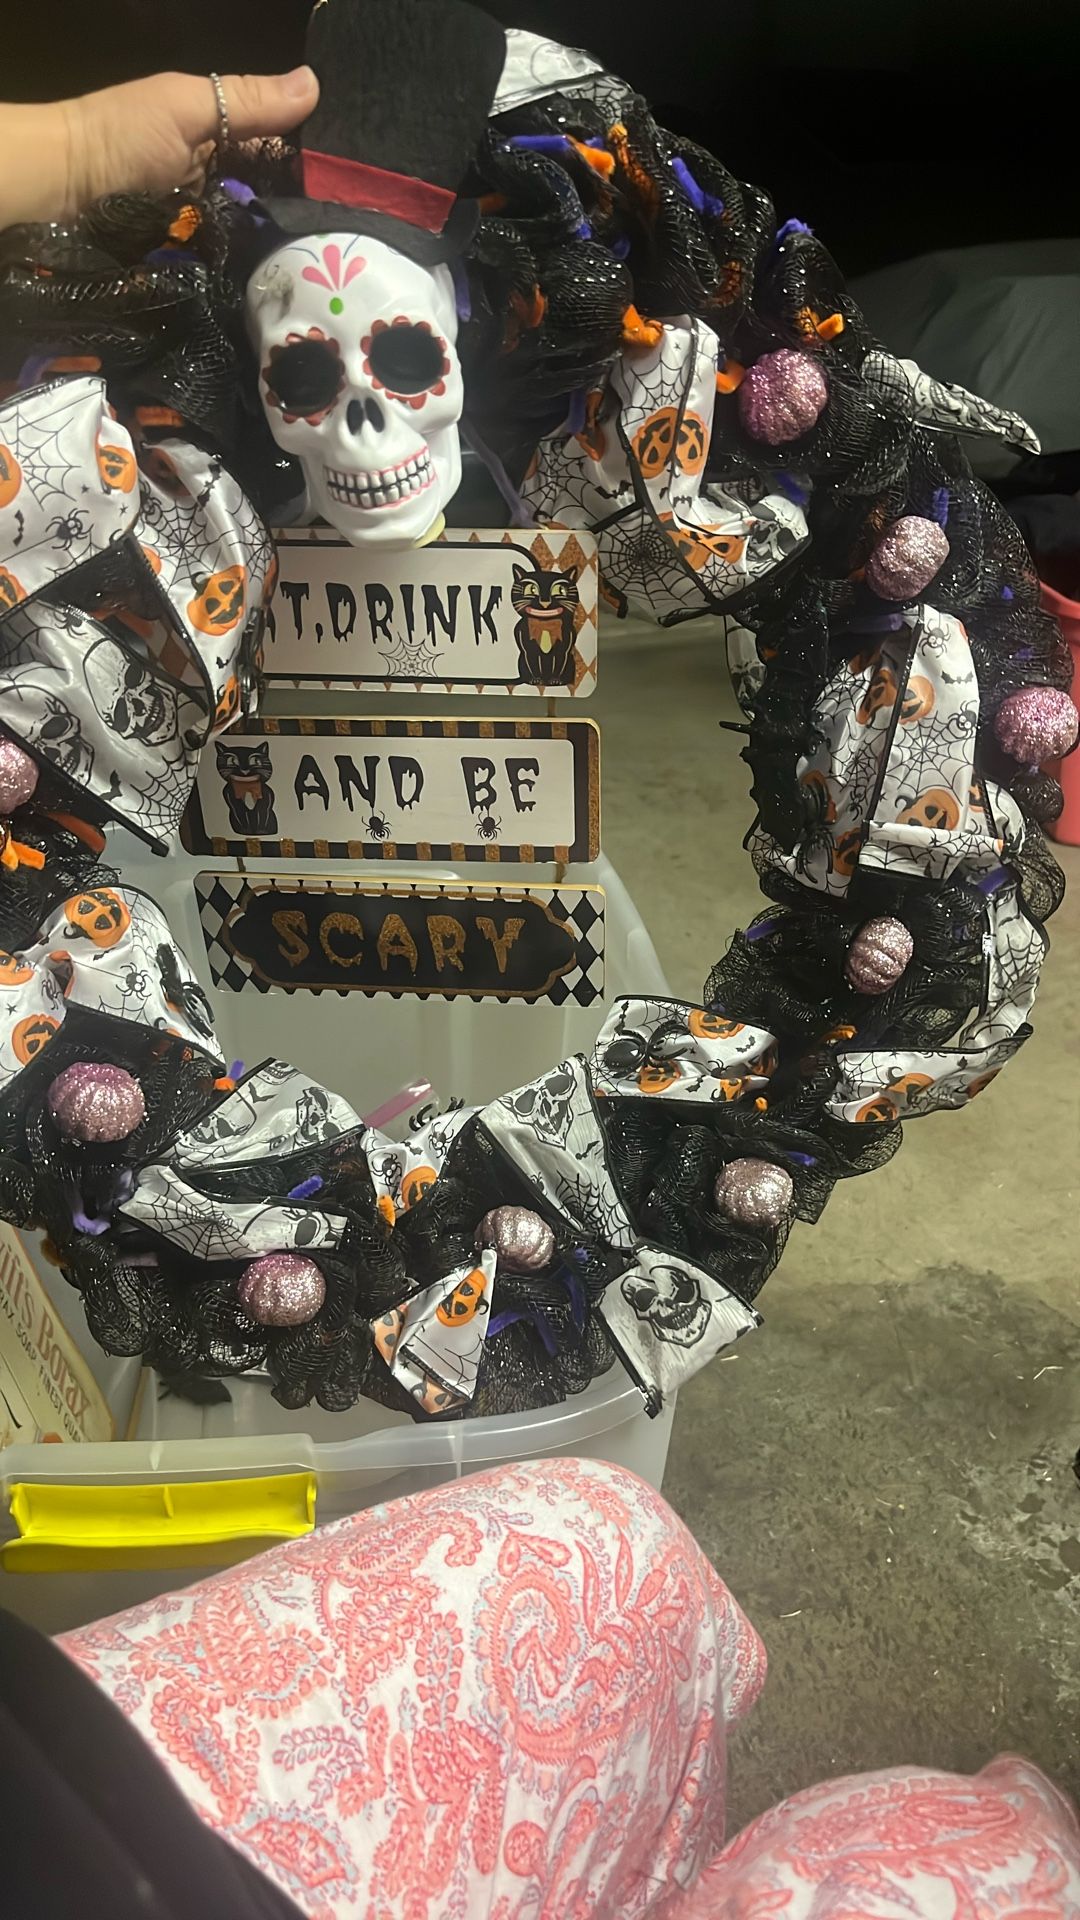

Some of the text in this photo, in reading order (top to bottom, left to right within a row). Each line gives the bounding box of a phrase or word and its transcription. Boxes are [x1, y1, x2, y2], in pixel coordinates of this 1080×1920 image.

[294, 754, 540, 814] AND BE
[271, 910, 525, 974] SCARY
[0, 1242, 91, 1441] ift's Borax
[16, 1322, 37, 1360] SOAP
[39, 1364, 63, 1415] FINEST
